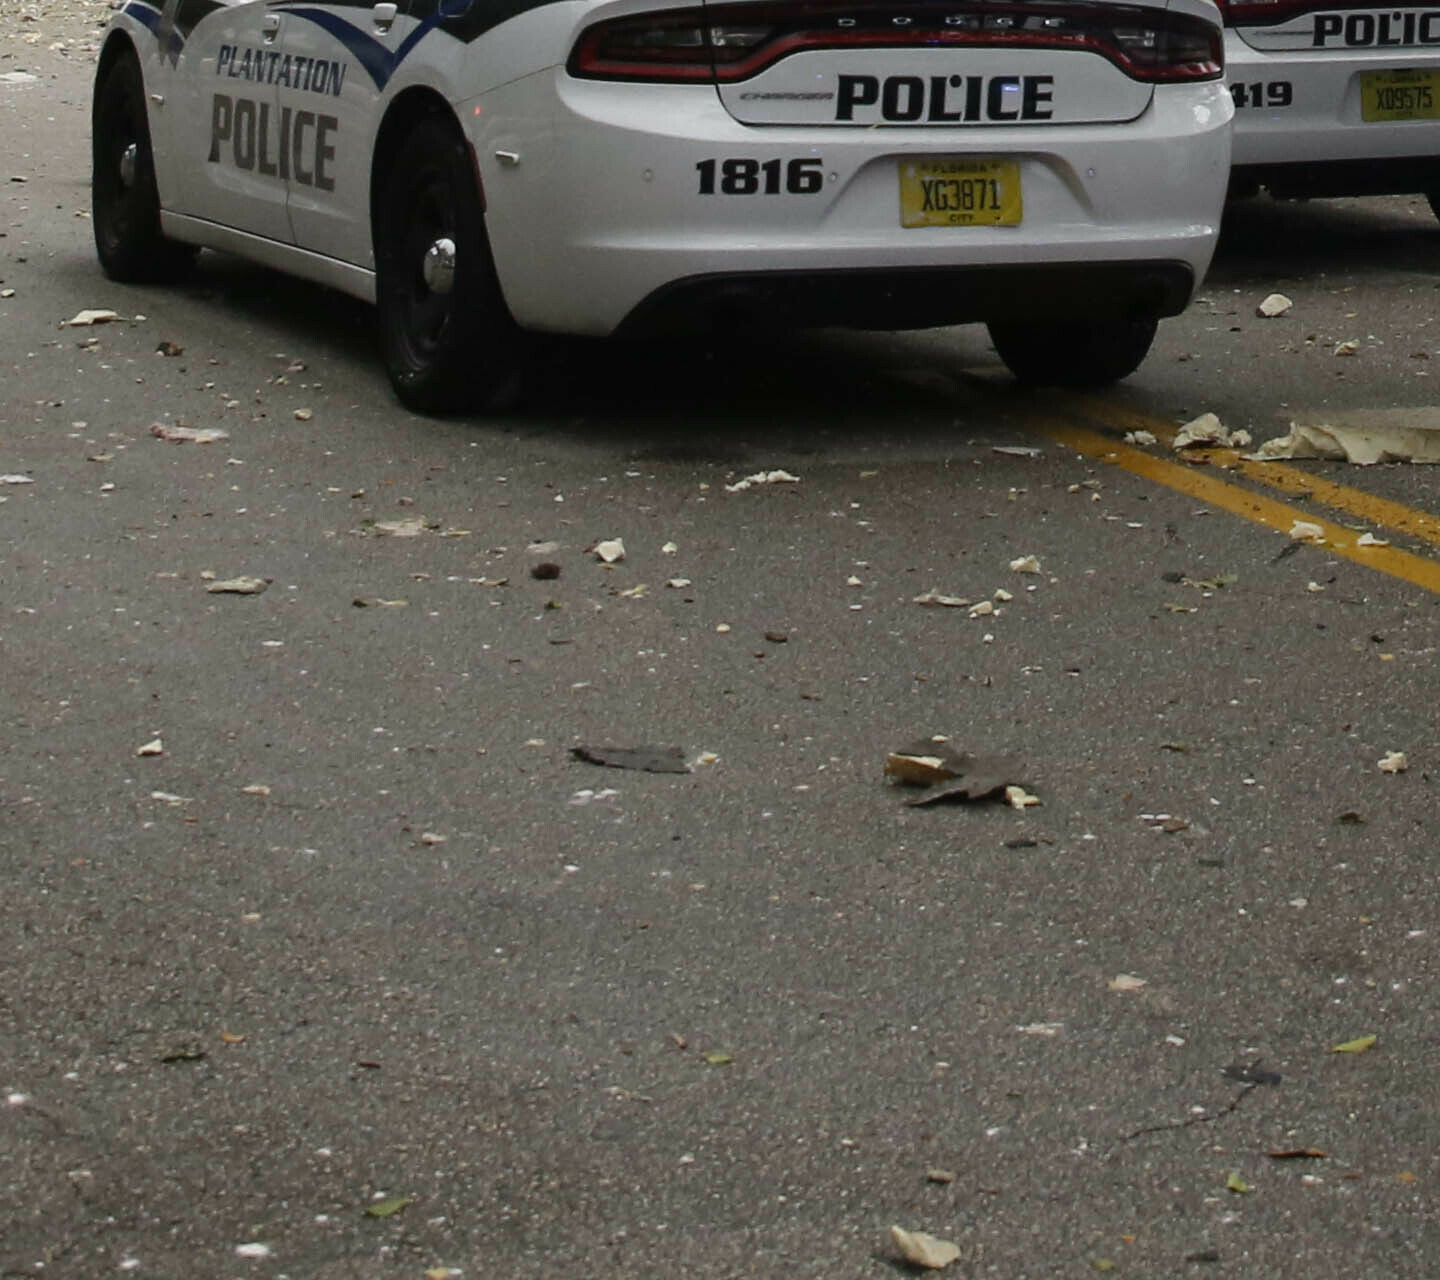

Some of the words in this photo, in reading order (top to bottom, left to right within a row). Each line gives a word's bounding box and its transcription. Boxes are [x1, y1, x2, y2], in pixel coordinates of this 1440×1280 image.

[216, 45, 347, 97] PLANTATION
[833, 74, 1053, 121] POLICE
[208, 94, 339, 191] POLICE
[696, 158, 823, 195] 1816
[921, 179, 1001, 211] XG3871
